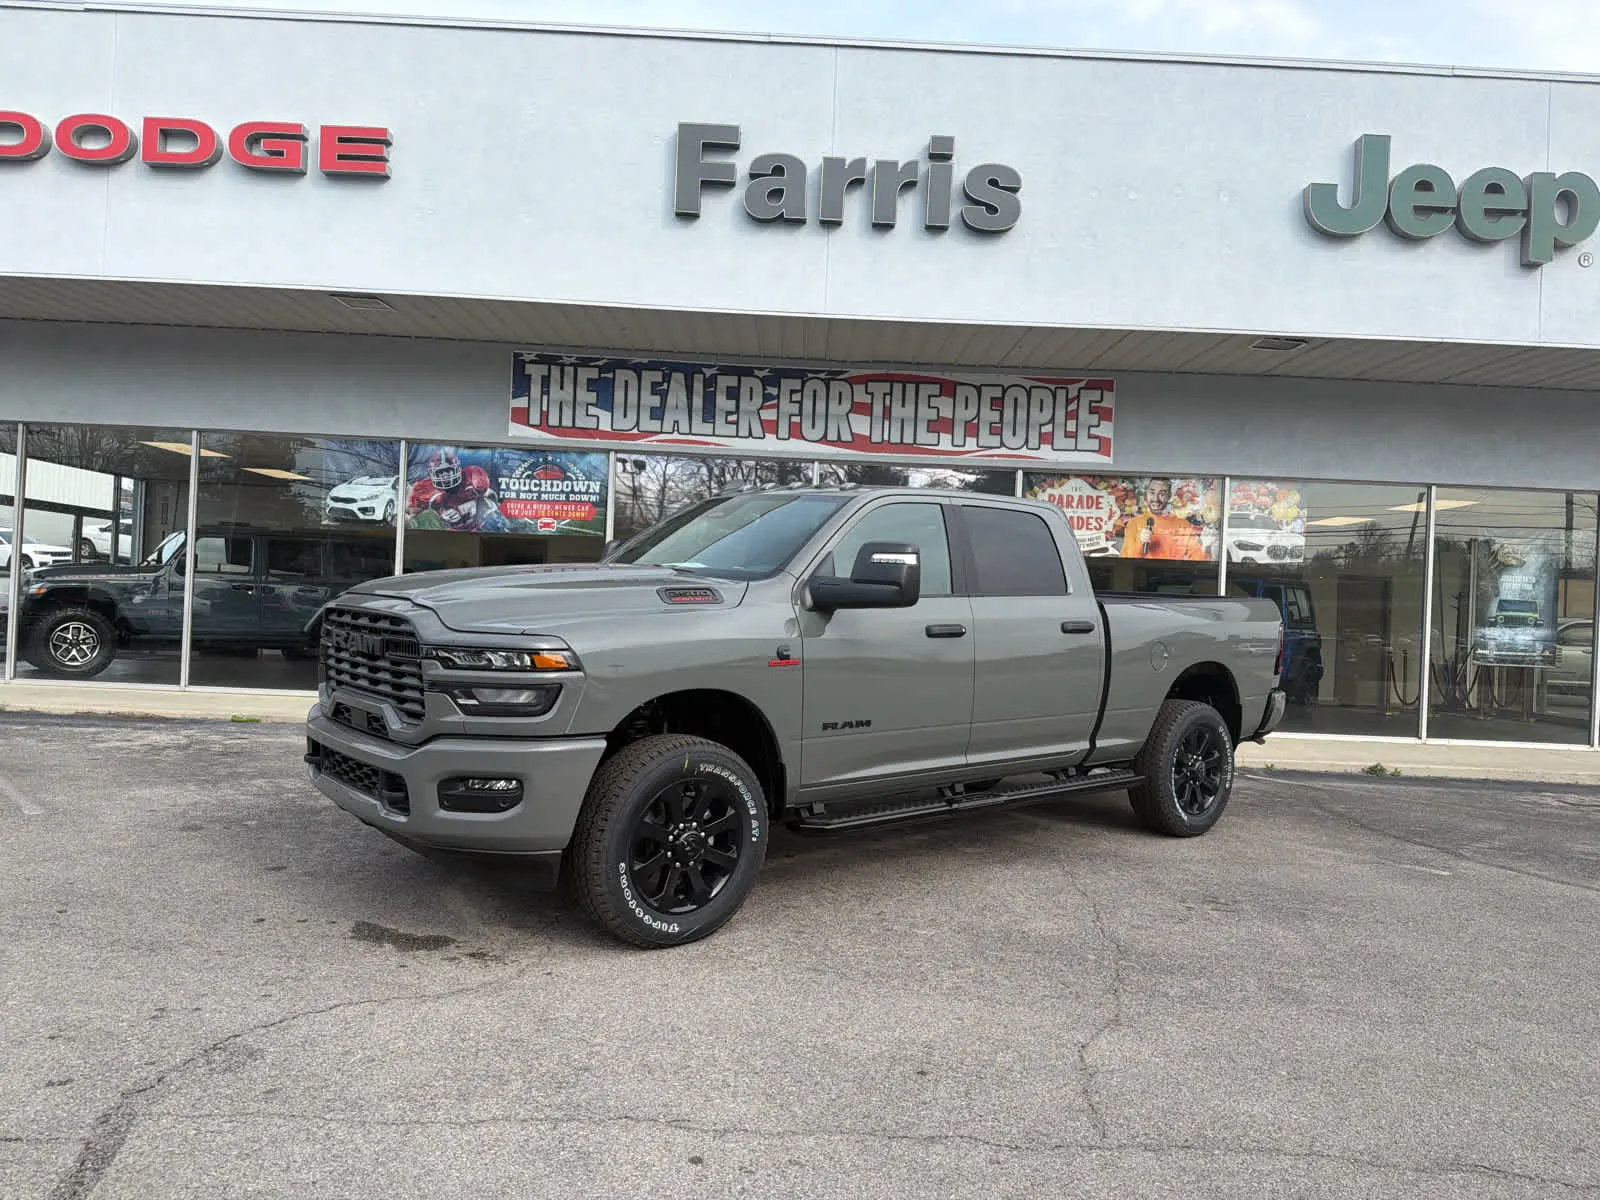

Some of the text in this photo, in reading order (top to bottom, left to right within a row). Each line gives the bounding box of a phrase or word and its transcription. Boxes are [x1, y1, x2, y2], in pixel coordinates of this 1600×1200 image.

[674, 121, 1022, 233] Farris
[1303, 133, 1600, 267] Jeep
[524, 362, 1104, 452] THE DEALER FOR THE PEOPLE
[498, 477, 601, 493] TOUCHDOWN
[499, 491, 600, 502] FOR NOT MUCH DOWN!
[1047, 493, 1104, 510] PARADE
[1068, 515, 1104, 531] ADES
[331, 629, 384, 657] RAM
[821, 719, 872, 731] RAM
